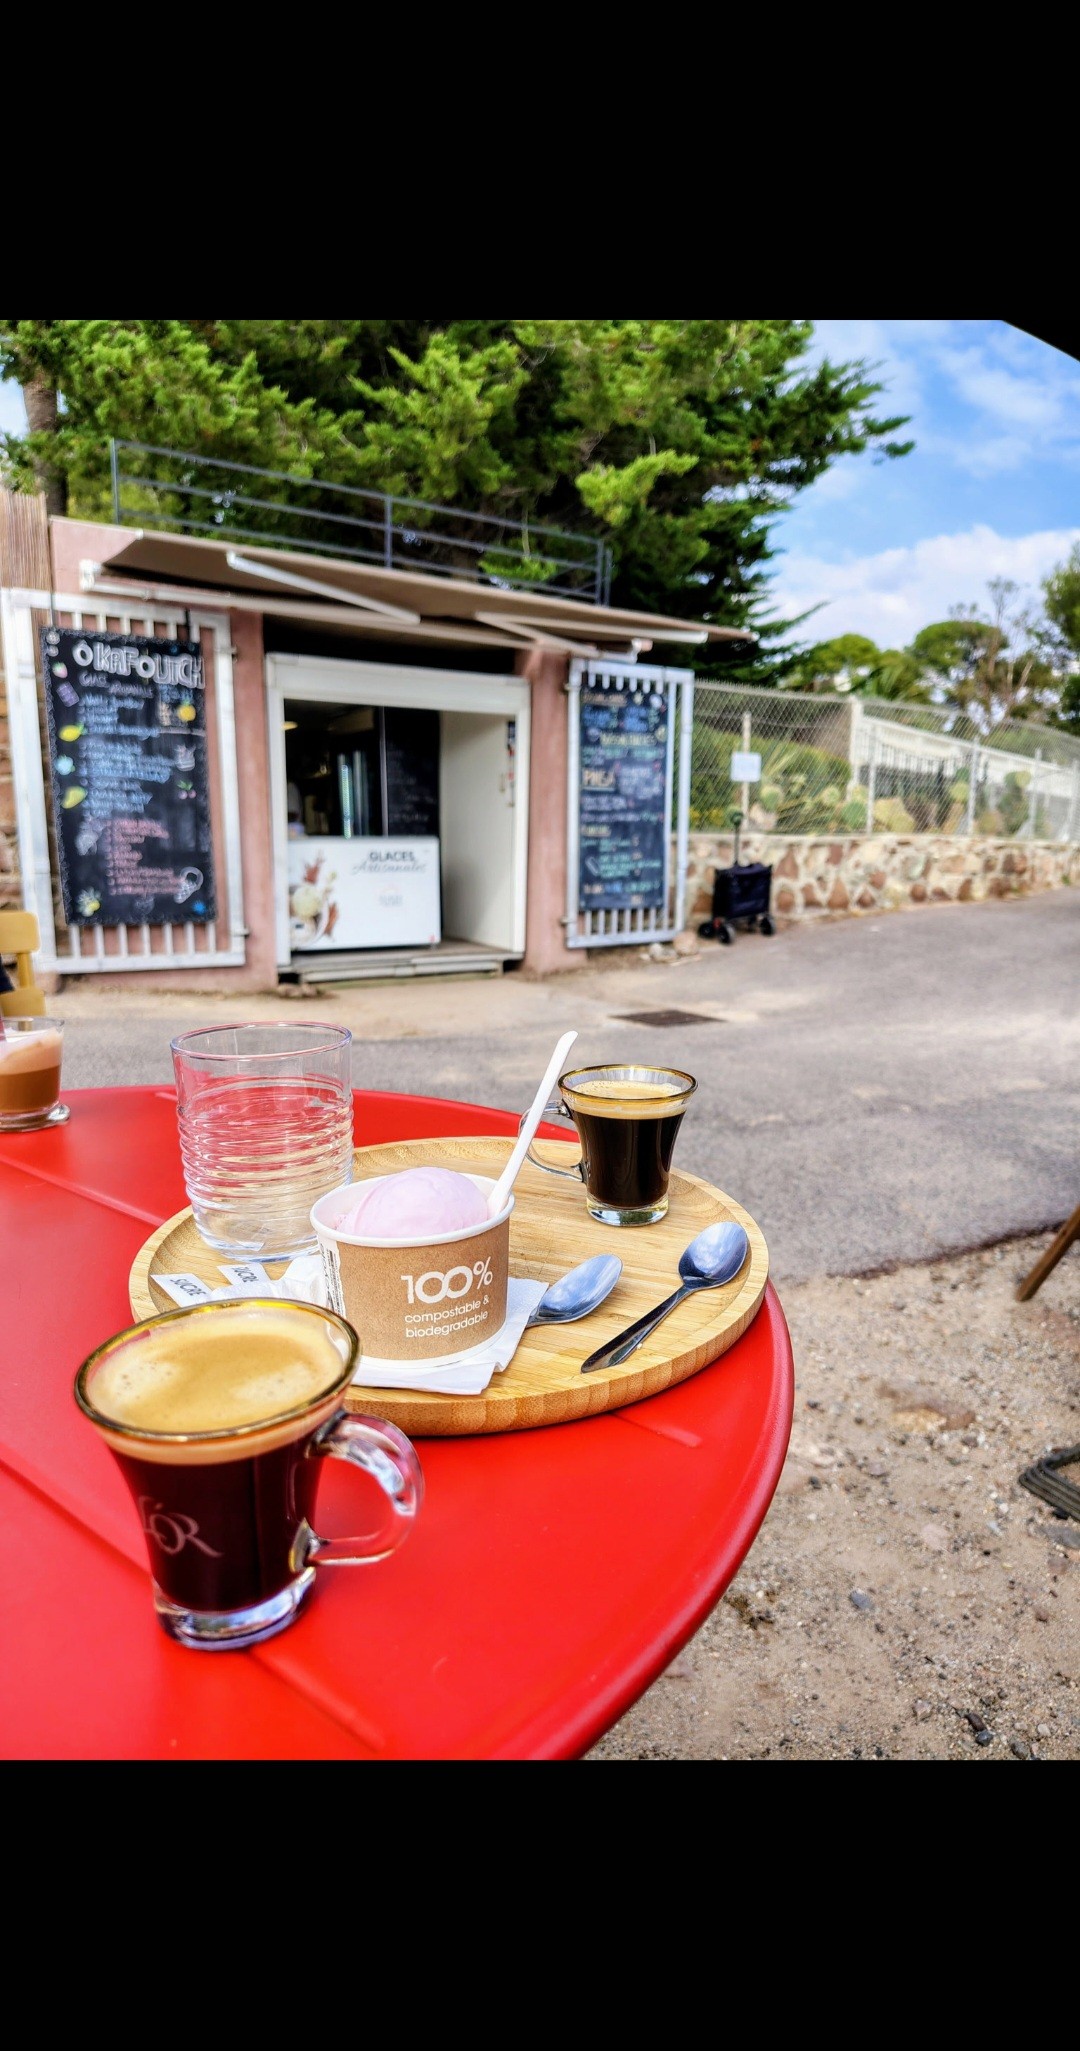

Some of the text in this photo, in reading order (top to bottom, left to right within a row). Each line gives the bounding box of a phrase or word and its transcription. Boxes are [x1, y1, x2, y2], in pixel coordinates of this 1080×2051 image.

[369, 850, 416, 862] GLACES
[169, 1278, 207, 1297] SUCRE
[400, 1256, 493, 1304] 100%
[404, 1295, 490, 1323] compostable &
[405, 1310, 489, 1338] biodegradable
